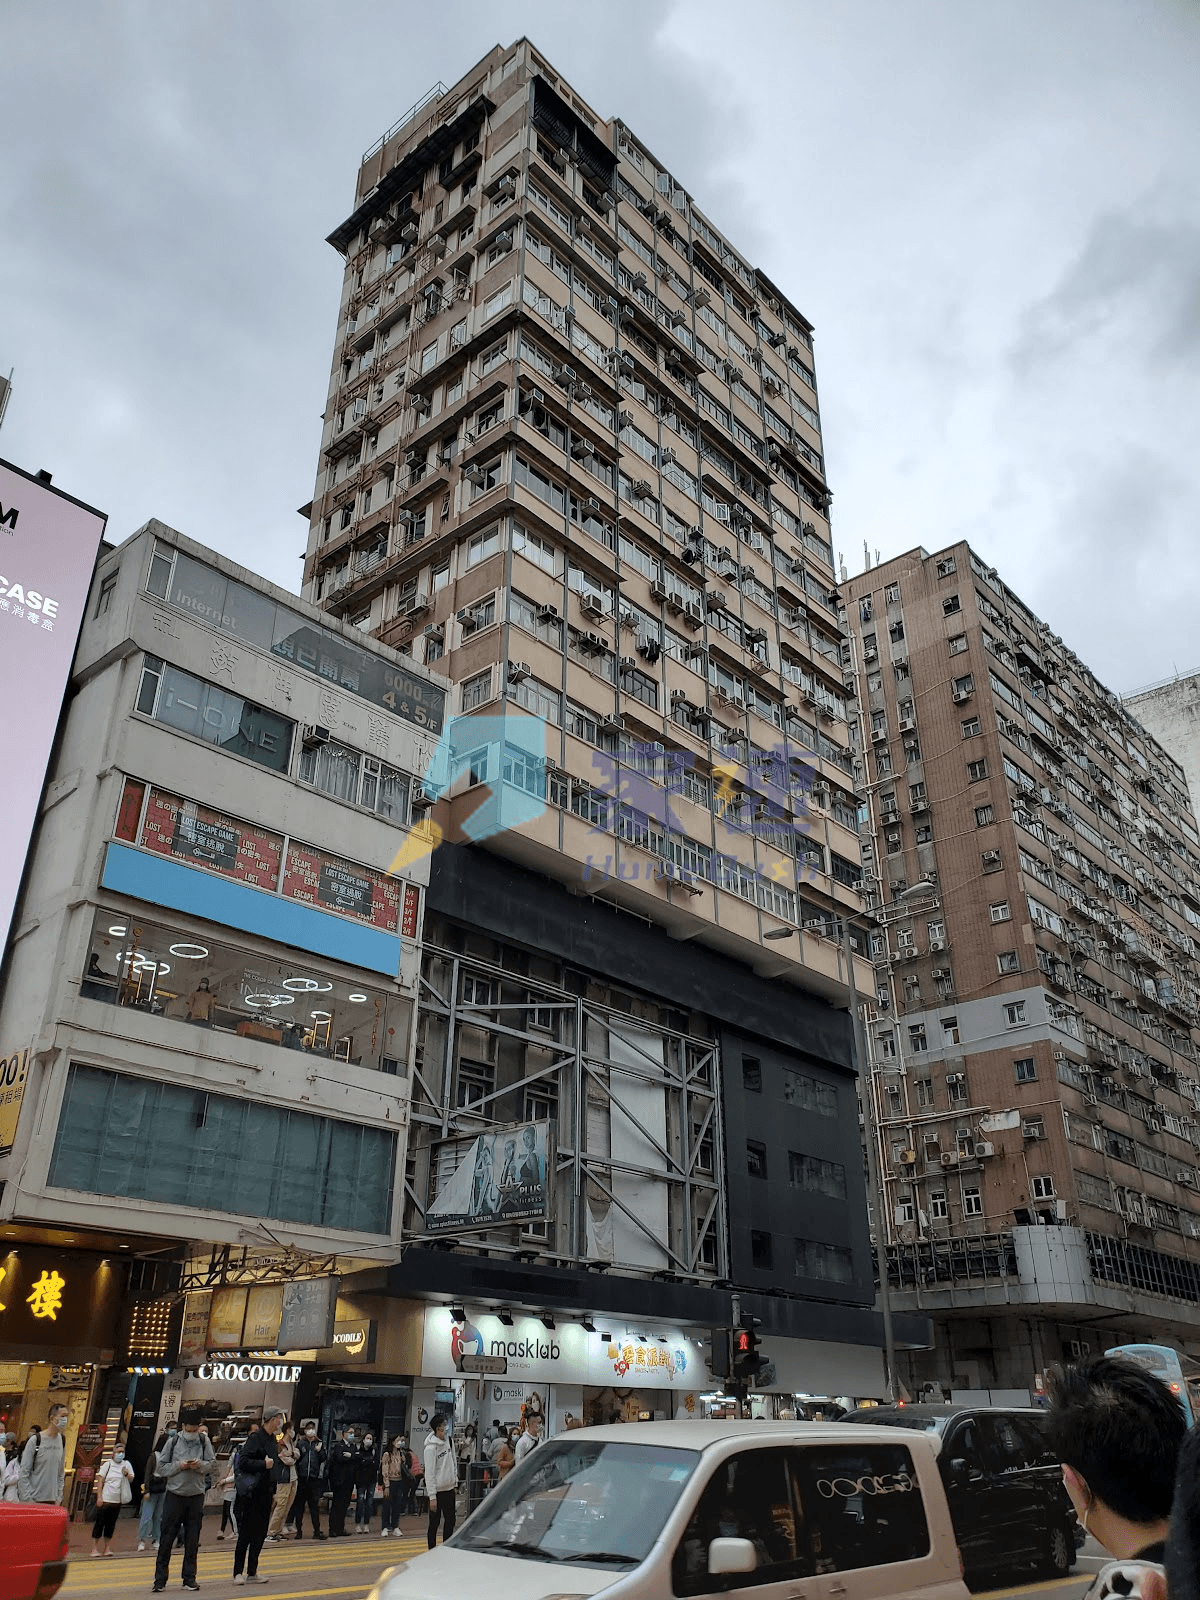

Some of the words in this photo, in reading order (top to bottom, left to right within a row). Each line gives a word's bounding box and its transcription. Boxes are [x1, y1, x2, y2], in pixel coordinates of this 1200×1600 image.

[176, 589, 236, 629] Internet
[384, 670, 422, 702] 6000
[382, 691, 396, 709] 4
[400, 701, 410, 714] &
[414, 705, 438, 730] 5/F
[145, 820, 161, 832] LOST
[182, 816, 196, 827] LOST
[196, 821, 218, 836] ESCAPE
[218, 829, 235, 842] GAME
[242, 839, 257, 851] LOST
[256, 860, 270, 872] LOST
[290, 857, 311, 870] ESCAPE
[245, 872, 259, 884] LOST
[325, 868, 337, 879] LOST
[337, 871, 356, 885] ESCAPE
[356, 878, 370, 890] GAME
[293, 888, 314, 902] ESCAPE
[384, 890, 399, 902] ESCAP
[372, 900, 386, 911] CAPE
[519, 1184, 542, 1196] PLUS
[255, 1324, 270, 1336] Hair
[490, 1338, 561, 1360] masklab
[199, 1363, 302, 1383] CROCODILE
